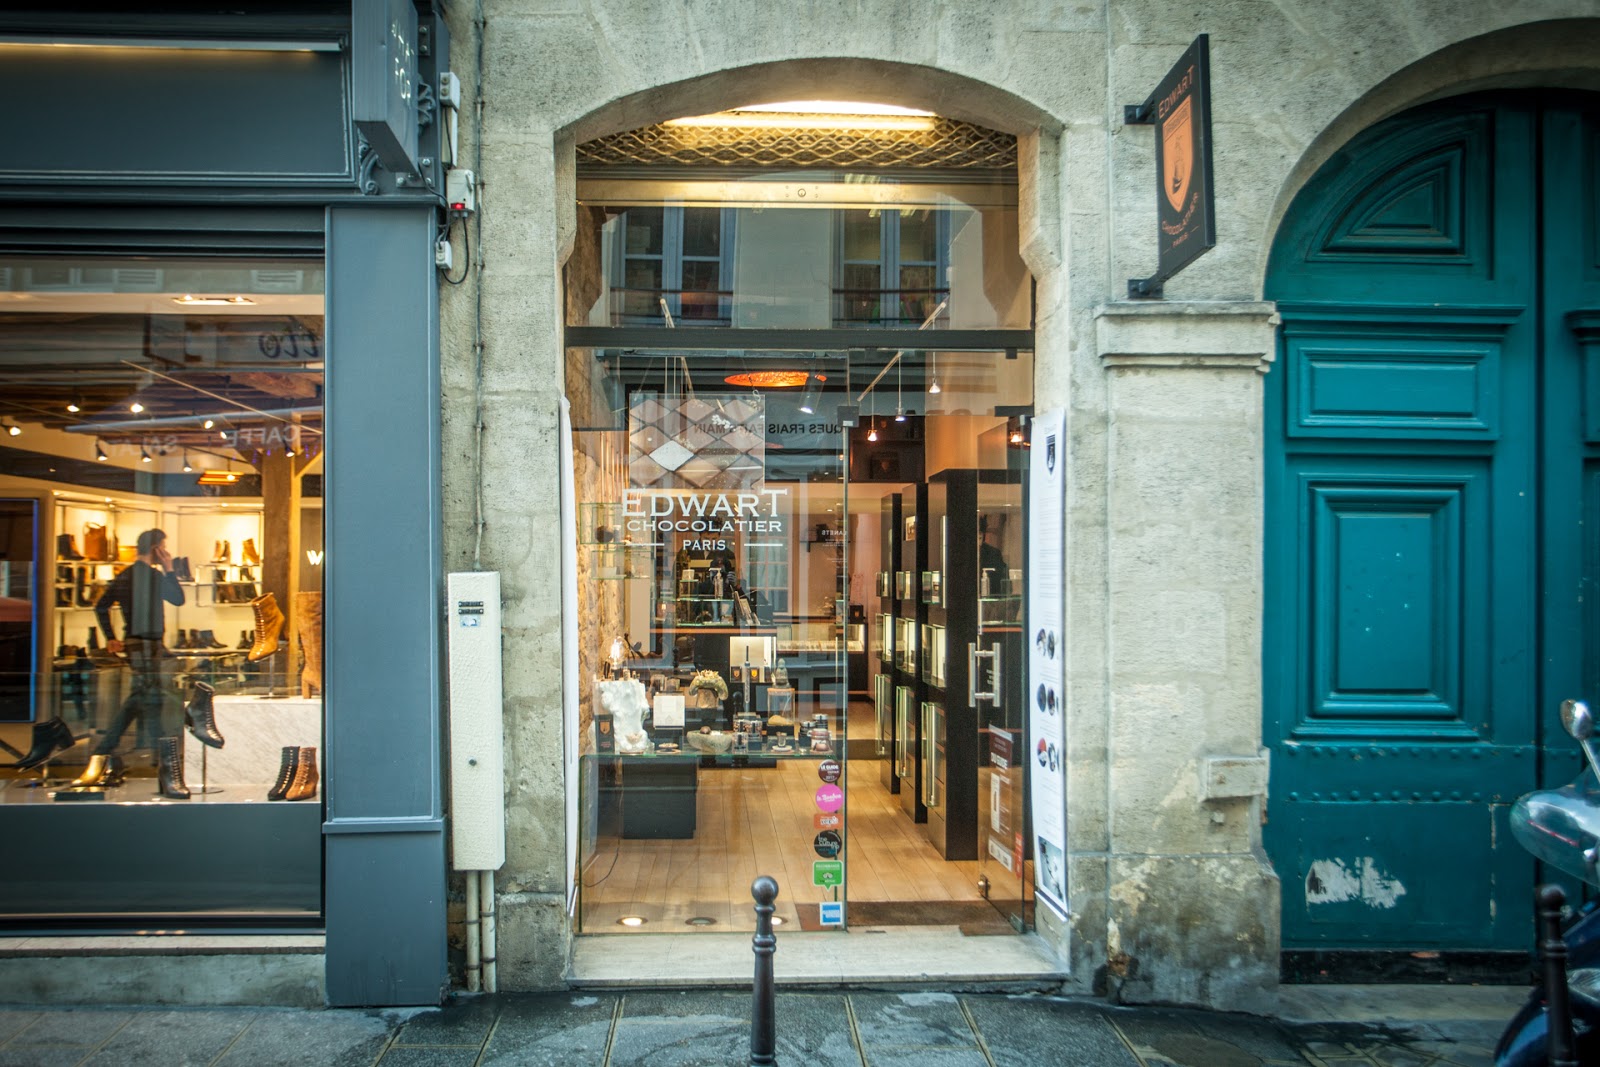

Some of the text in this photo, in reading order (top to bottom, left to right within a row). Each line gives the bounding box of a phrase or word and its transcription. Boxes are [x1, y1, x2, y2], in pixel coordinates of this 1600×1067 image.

[1158, 65, 1195, 119] EDWART
[622, 488, 788, 517] EDWART
[626, 520, 782, 532] CHOCOLATIER
[683, 539, 726, 551] PARIS
